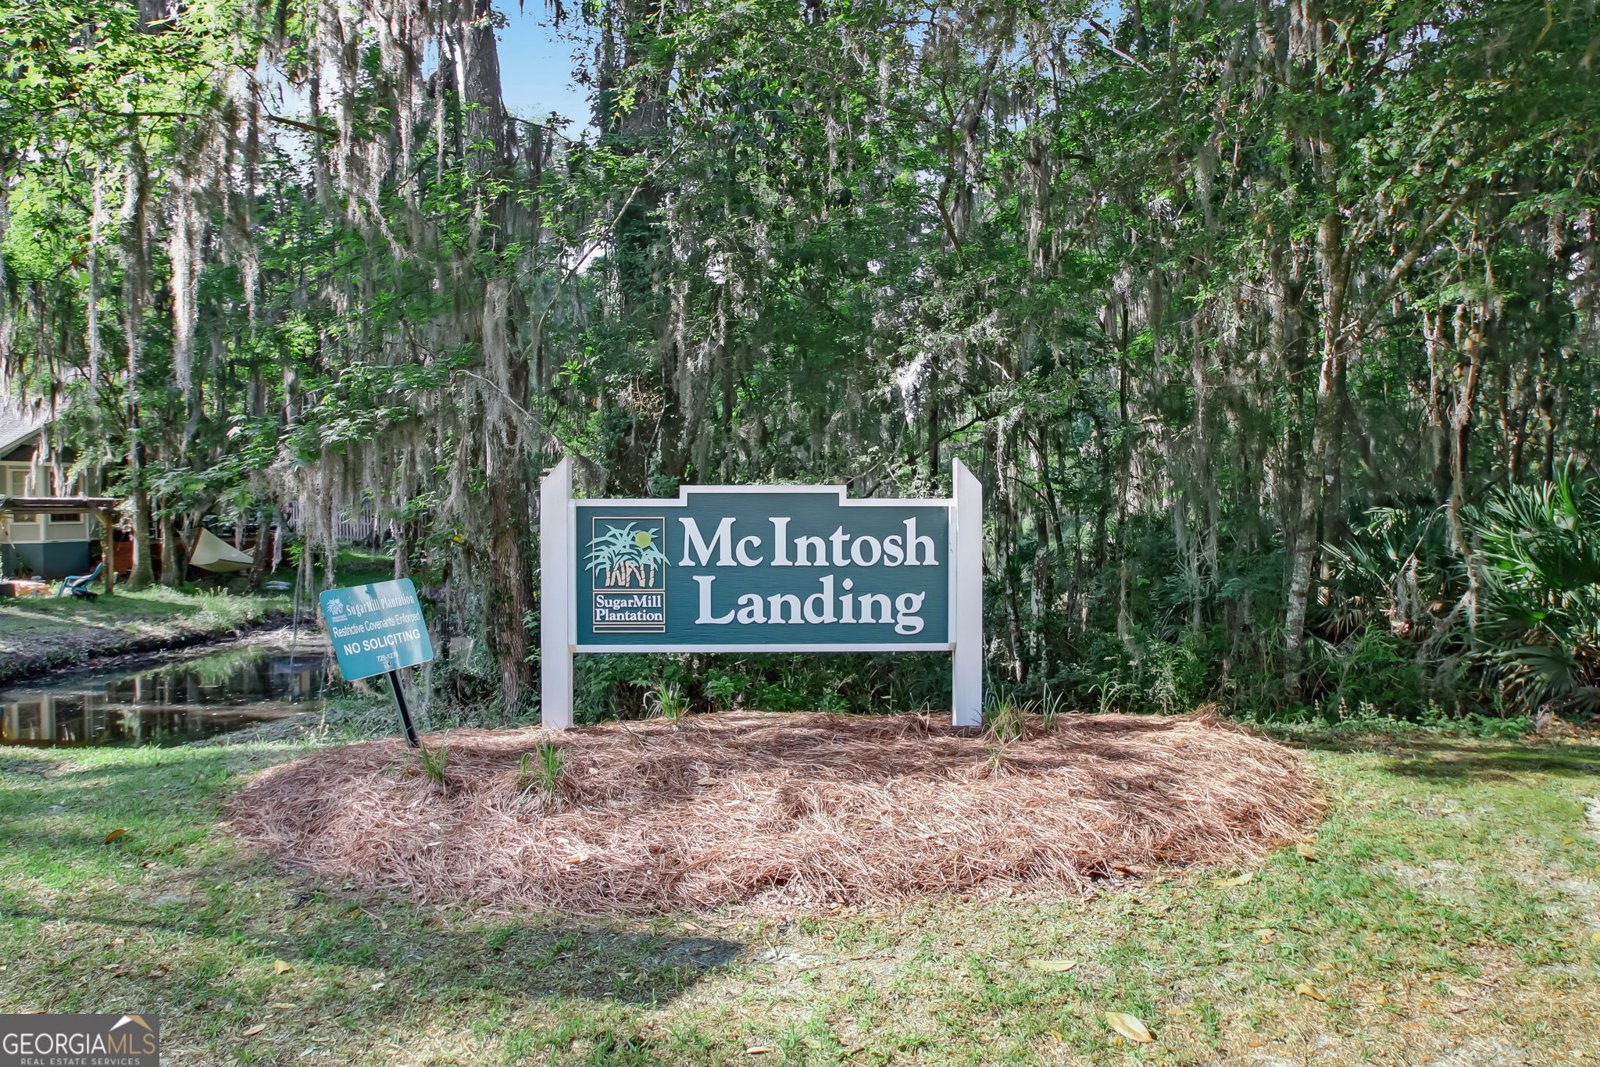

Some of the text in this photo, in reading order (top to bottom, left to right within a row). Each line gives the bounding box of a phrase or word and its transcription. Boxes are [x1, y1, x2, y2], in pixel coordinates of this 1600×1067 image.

[380, 594, 414, 609] Plantation
[596, 594, 662, 610] SugarMill
[692, 574, 926, 635] Landing
[333, 611, 420, 638] Restrictive Covenants Enforced
[595, 608, 663, 621] Plantation
[343, 629, 421, 656] NO SOLICITING
